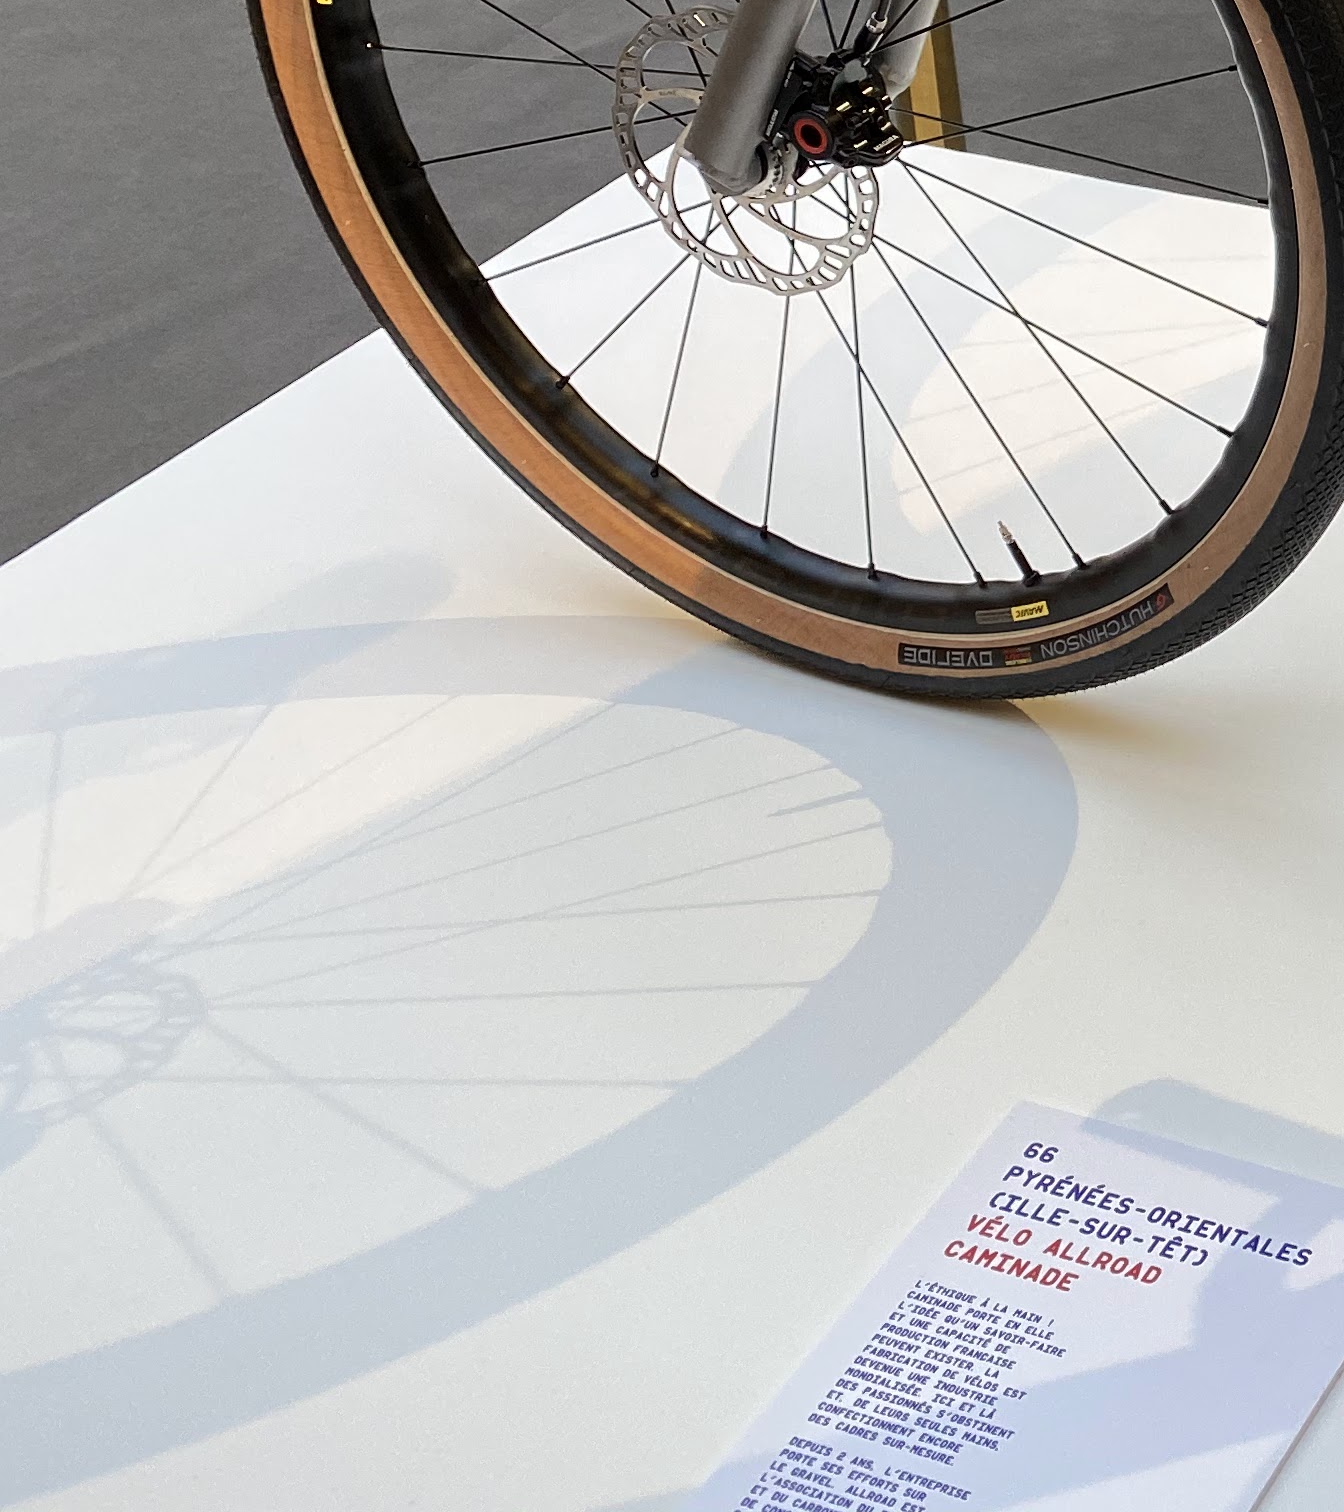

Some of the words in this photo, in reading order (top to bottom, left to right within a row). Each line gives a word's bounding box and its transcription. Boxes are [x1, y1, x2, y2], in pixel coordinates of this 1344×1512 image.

[1014, 604, 1045, 619] MAVIC
[1040, 601, 1155, 659] HUTCHINSON
[1023, 1142, 1059, 1163] 66
[989, 1191, 1209, 1267] (ILLE-SUR-TÊT)
[1002, 1165, 1313, 1266] PYRÉNÉES-ORIENTALES
[944, 1240, 1080, 1292] CAMINADE
[967, 1214, 1033, 1246] VÉLO
[1042, 1238, 1162, 1284] ALLROAD
[879, 1322, 951, 1350] PRODUCTION
[888, 1311, 906, 1322] ET
[909, 1317, 933, 1331] UNE
[935, 1325, 992, 1349] CAPACITÉ
[994, 1343, 1012, 1355] DE
[897, 1300, 941, 1320] L'IDÉE
[944, 1314, 981, 1332] QU'UN
[982, 1326, 1067, 1358] SAVOIR-FAIRE
[906, 1290, 963, 1313] CAMINADE
[964, 1307, 1002, 1325] PORTE
[1004, 1319, 1022, 1331] EN
[1024, 1325, 1055, 1341] ELLE
[992, 1302, 1008, 1314] LA
[1012, 1308, 1043, 1324] MAIN
[853, 1355, 904, 1377] DEVENUE
[907, 1371, 931, 1386] UNE
[933, 1379, 999, 1407] INDUSTRIE
[862, 1344, 940, 1374] FABRICATION
[941, 1368, 960, 1380] DE
[963, 1374, 999, 1392] VÉLOS
[1002, 1387, 1028, 1400] EST
[871, 1333, 922, 1354] PEUVENT
[984, 1367, 1001, 1380] LA
[807, 1413, 832, 1427] DES
[835, 1421, 879, 1441] CADRES
[817, 1401, 916, 1438] CONFECTIONNENT
[918, 1432, 964, 1454] ENCORE
[835, 1378, 859, 1392] DES
[861, 1386, 933, 1414] PASSIONNÉS
[936, 1409, 1015, 1440] S'OBSTINENT
[853, 1397, 872, 1411] DE
[872, 1403, 911, 1422] LEURS
[913, 1416, 958, 1437] SEULES
[930, 1395, 957, 1409] ICI
[958, 1401, 976, 1413] ET
[759, 1472, 854, 1509] L'ASSOCIATION
[769, 1460, 788, 1473] LE
[844, 1485, 897, 1508] ALLROAD
[778, 1448, 818, 1467] PORTE
[820, 1461, 845, 1475] SES
[847, 1470, 900, 1493] EFFORTS
[902, 1487, 927, 1502] SUR
[788, 1436, 833, 1457] DEPUIS
[836, 1451, 847, 1462] 2
[884, 1466, 972, 1501] L'ENTREPRISE
[740, 1496, 759, 1510] DE
[750, 1484, 769, 1497] ET
[770, 1491, 790, 1503] DU
